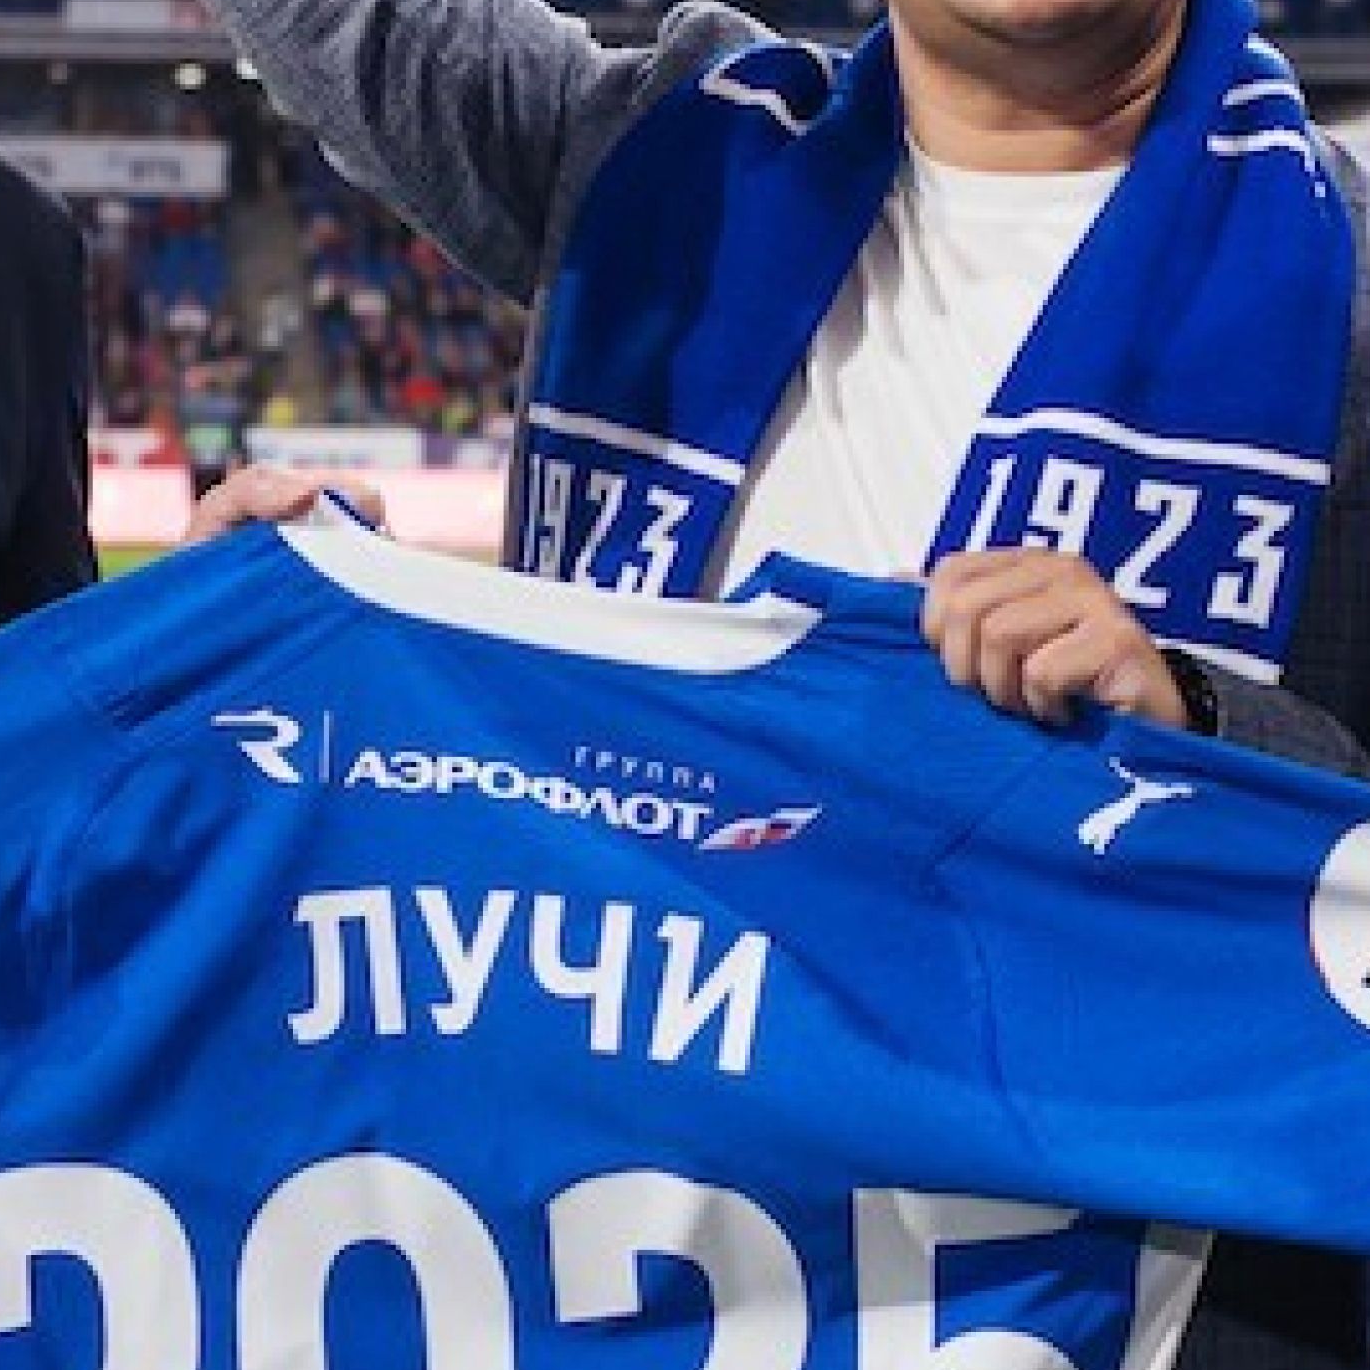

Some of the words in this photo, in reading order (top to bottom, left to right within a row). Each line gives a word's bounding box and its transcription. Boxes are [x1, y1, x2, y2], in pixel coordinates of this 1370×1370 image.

[524, 453, 693, 599] 1923
[963, 453, 1295, 629] 1923
[344, 748, 714, 841] АЭРОФЛОТ
[574, 746, 717, 794] ГРУППА
[287, 885, 771, 1074] ЛУЧИ
